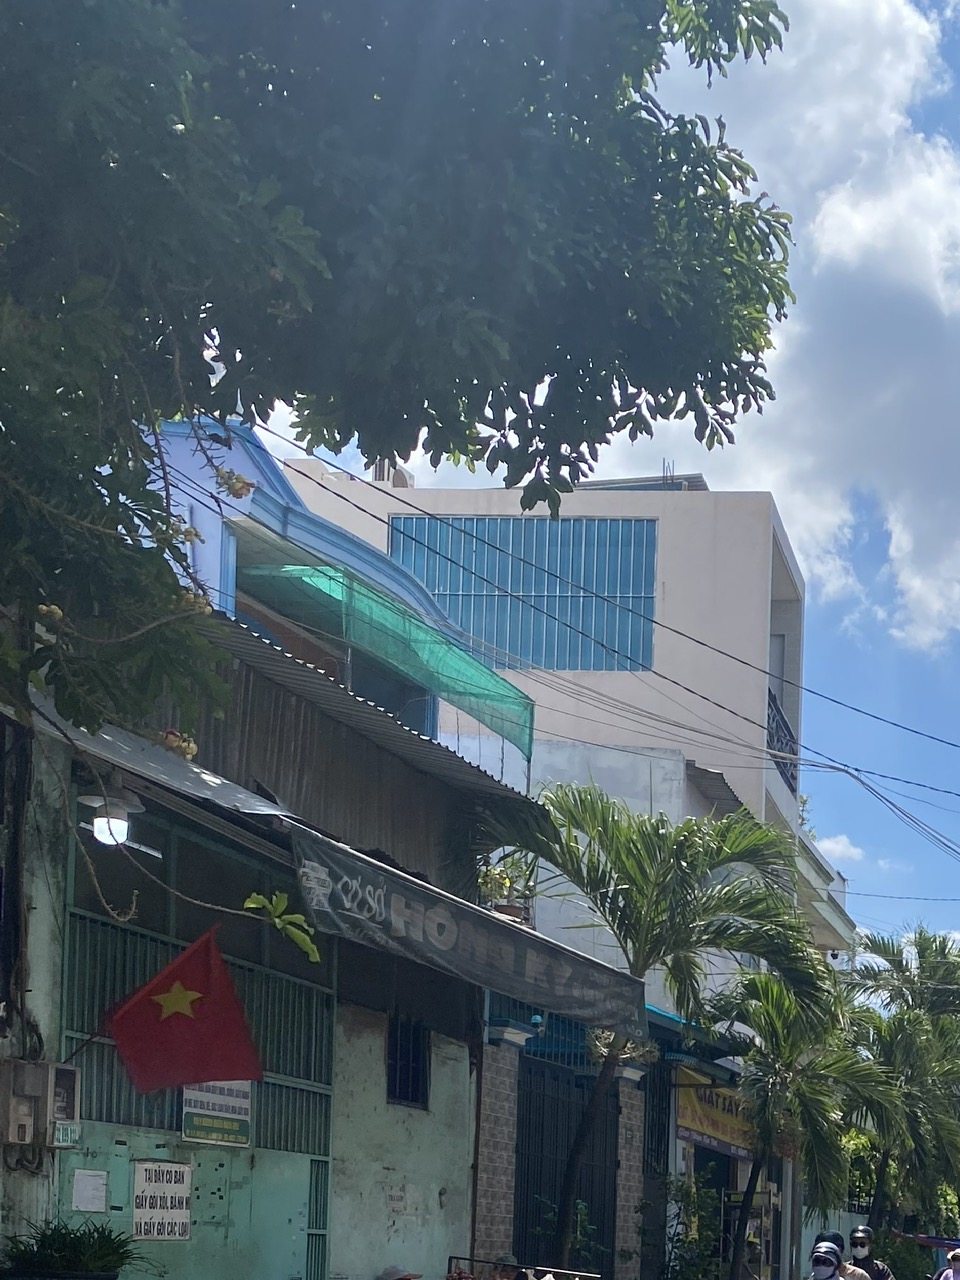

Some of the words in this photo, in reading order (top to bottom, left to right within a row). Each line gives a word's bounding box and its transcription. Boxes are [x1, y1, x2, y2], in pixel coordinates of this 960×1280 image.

[173, 1166, 185, 1185] BÁN
[170, 1192, 184, 1211] BÁNH
[143, 1216, 156, 1237] GIẤY
[156, 1218, 166, 1237] GÓI
[166, 1219, 177, 1237] CÁC
